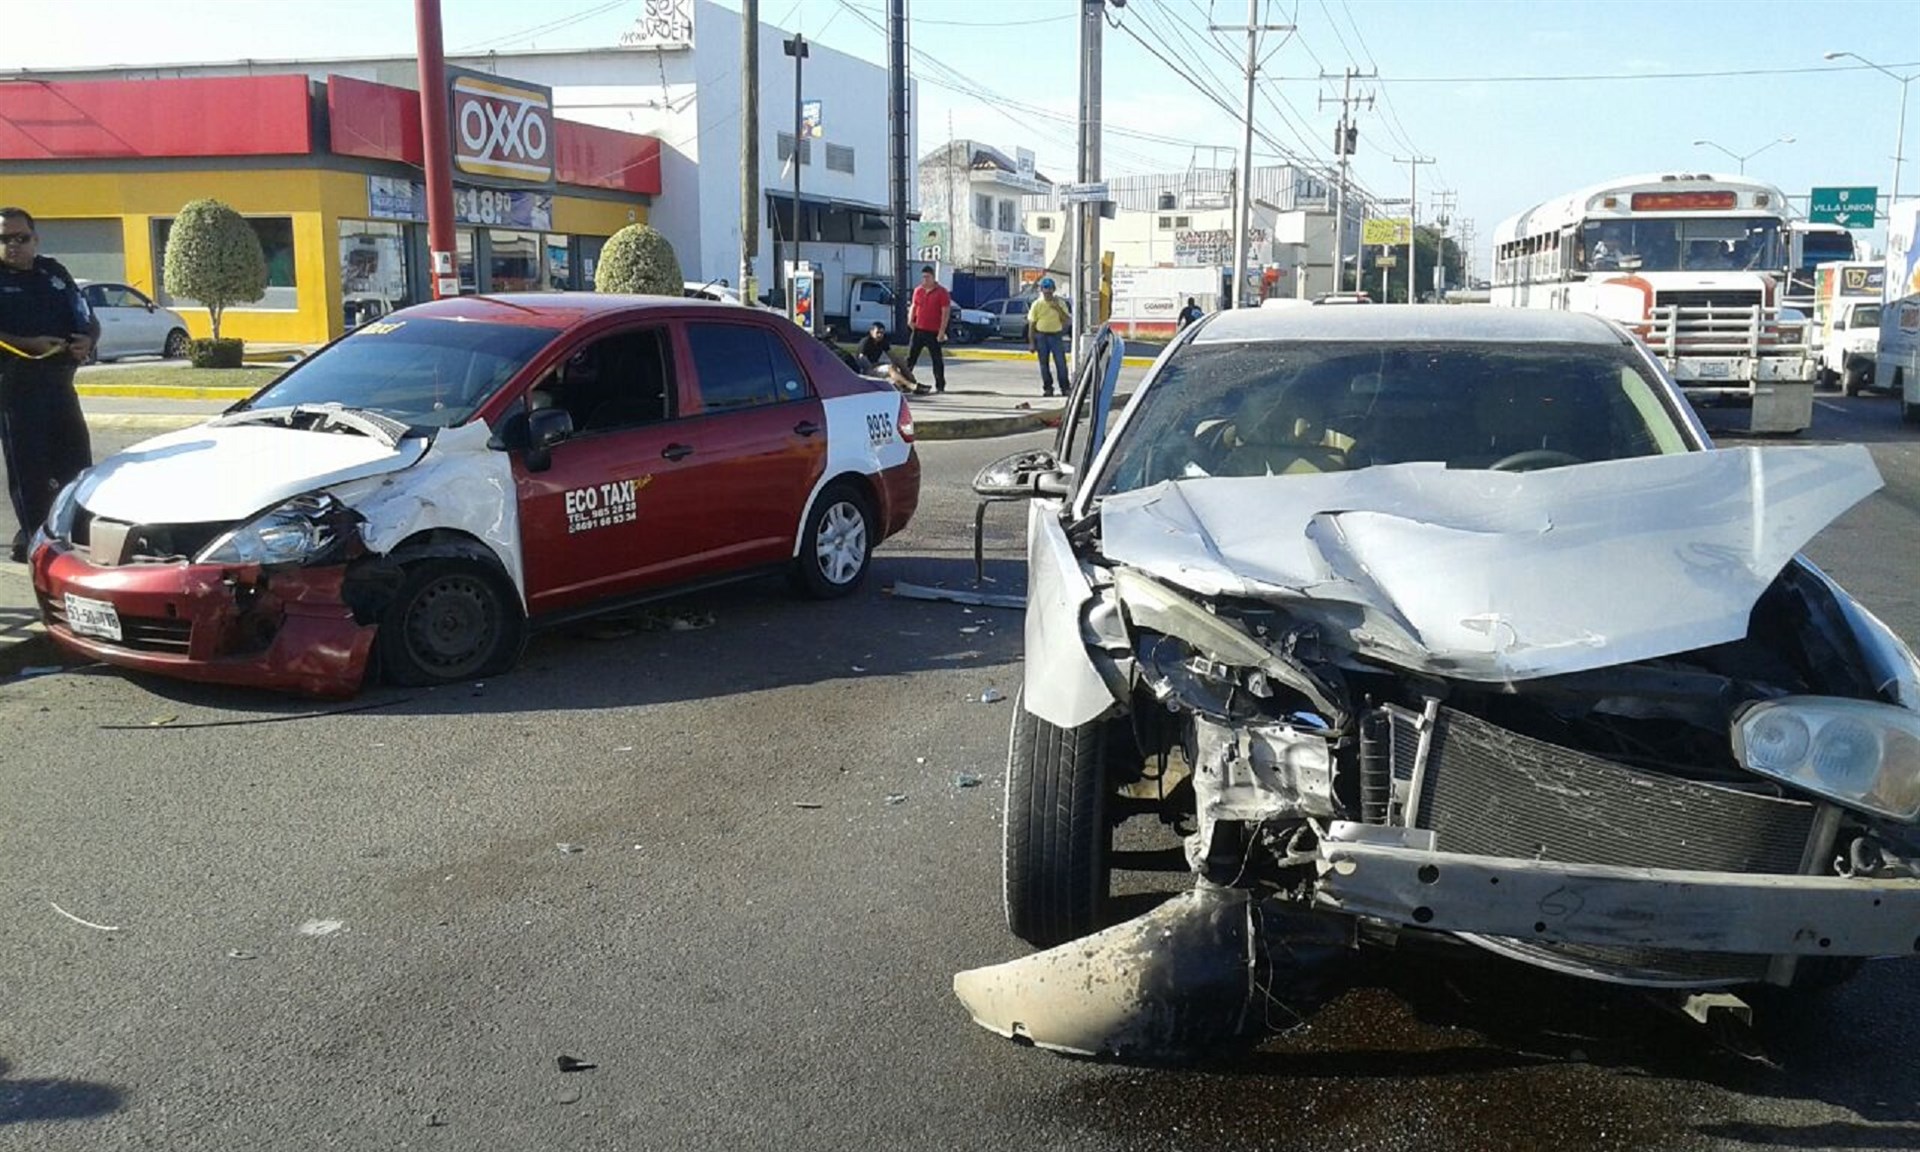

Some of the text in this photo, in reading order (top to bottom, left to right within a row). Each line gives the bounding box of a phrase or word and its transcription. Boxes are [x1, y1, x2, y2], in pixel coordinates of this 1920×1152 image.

[461, 100, 546, 160] OXXO
[1813, 204, 1874, 212] VILLA UNION
[866, 412, 893, 440] 8935
[565, 487, 598, 514] ECO
[600, 480, 635, 506] TAXI
